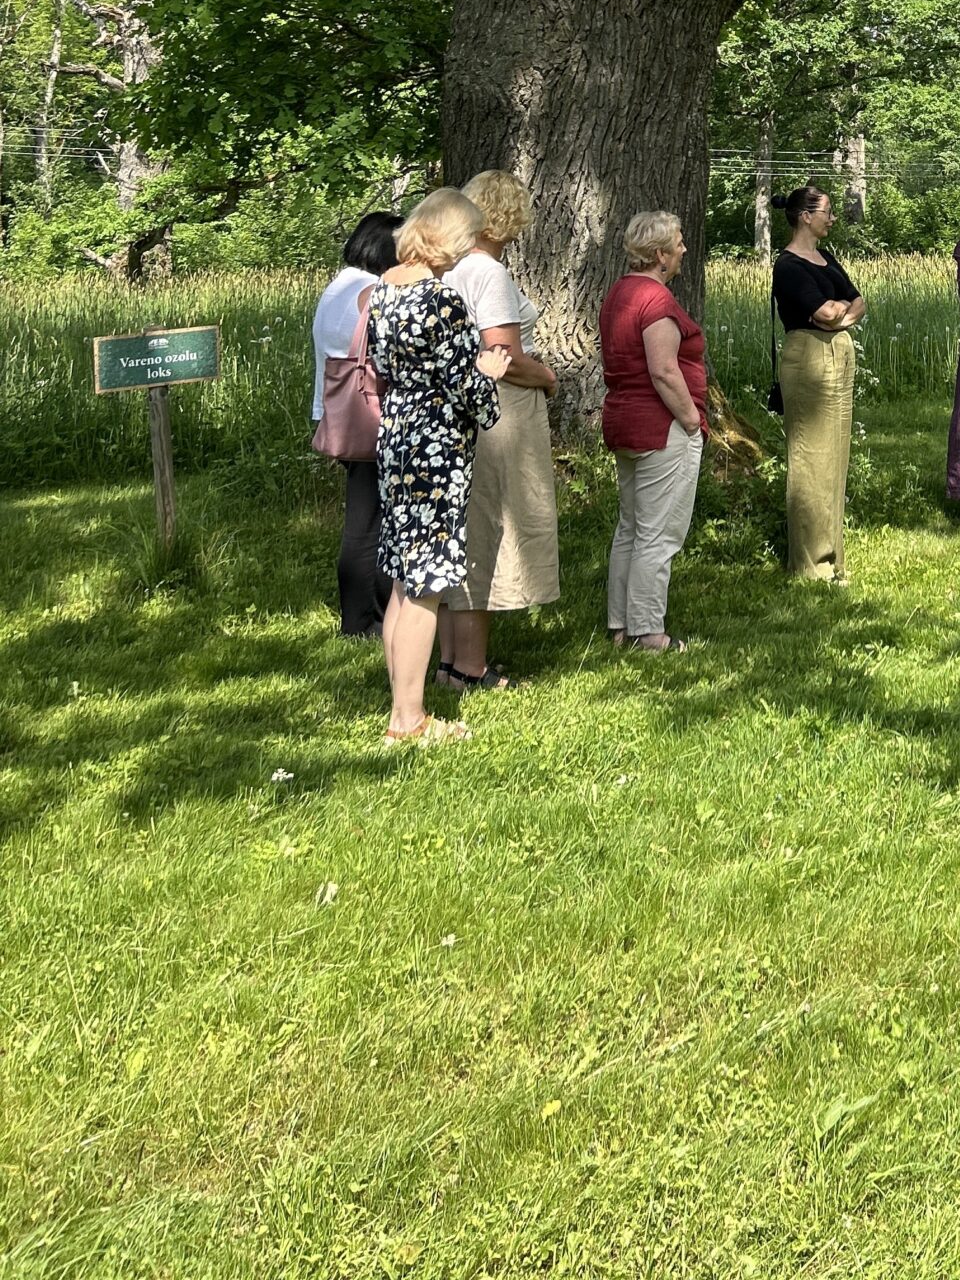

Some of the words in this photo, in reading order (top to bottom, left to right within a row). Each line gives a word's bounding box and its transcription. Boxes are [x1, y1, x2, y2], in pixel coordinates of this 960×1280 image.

[120, 356, 162, 368] Vareno
[164, 350, 197, 363] ozolu
[147, 367, 171, 379] loks
